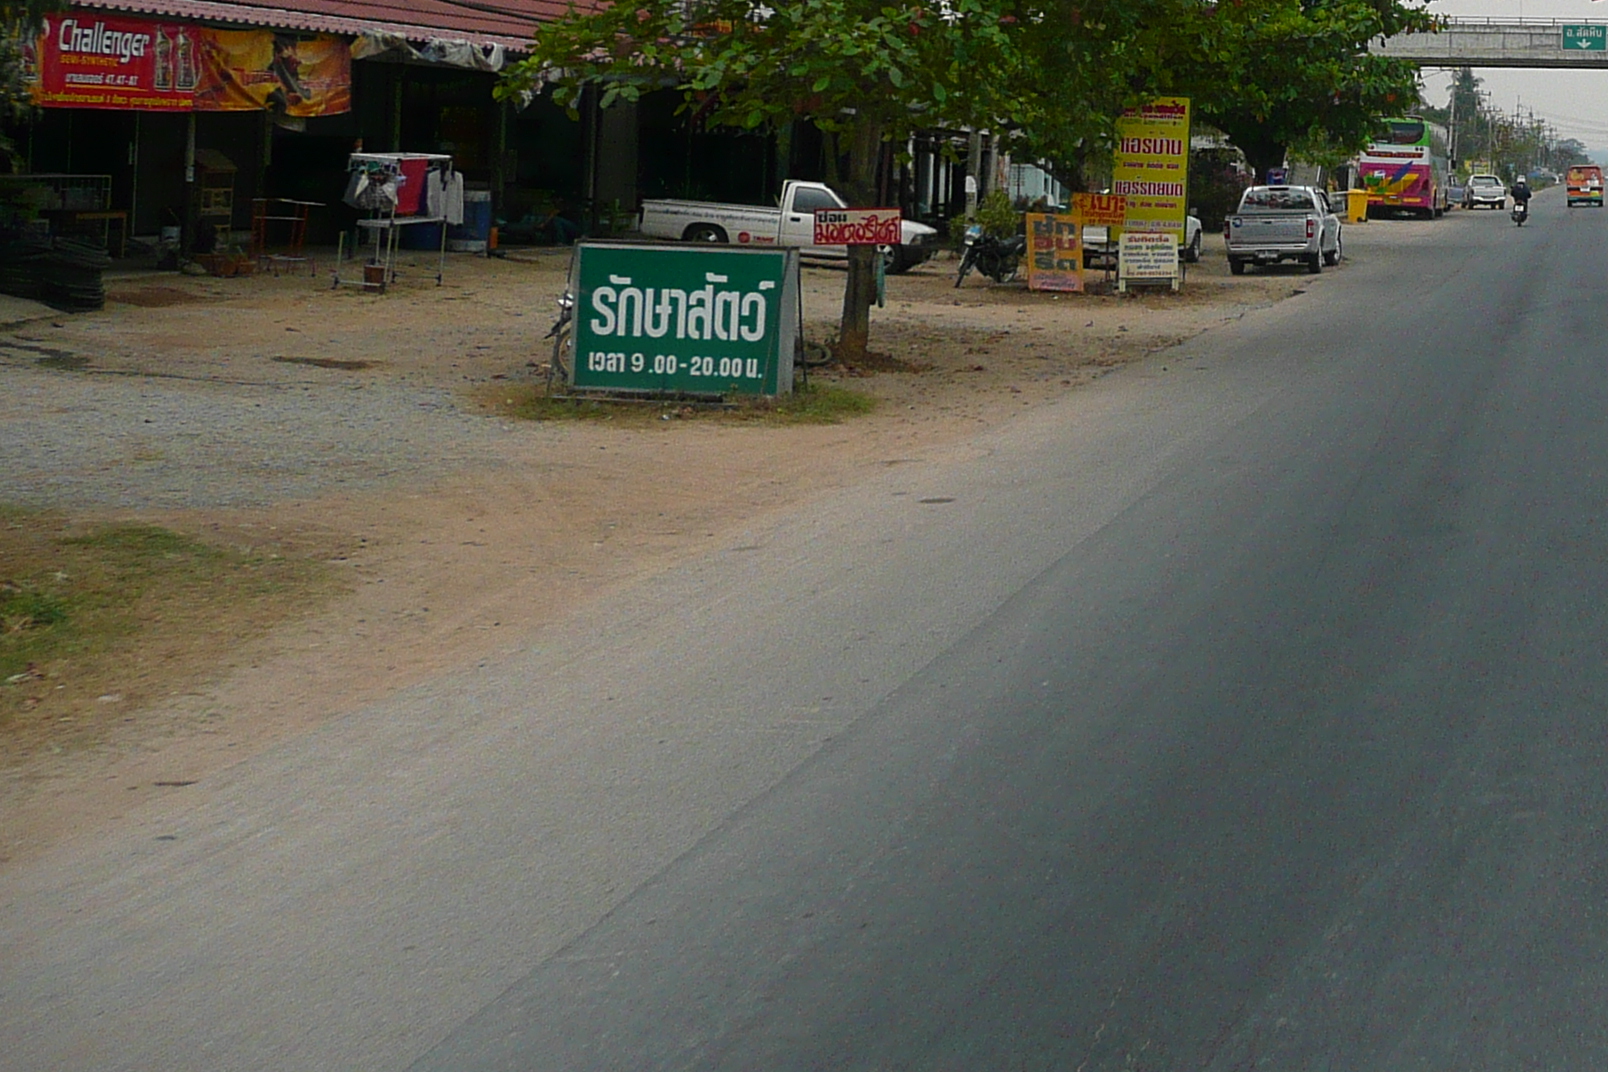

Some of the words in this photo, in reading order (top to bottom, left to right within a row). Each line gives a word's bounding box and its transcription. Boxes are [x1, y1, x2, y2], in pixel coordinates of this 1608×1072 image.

[58, 18, 150, 64] Challenger
[1120, 130, 1182, 156] แอร์บ้าน
[1115, 175, 1184, 197] แอร์รถยนต์
[1091, 194, 1126, 213] เบาะ
[817, 210, 848, 223] ซ่อม
[590, 272, 776, 342] รักษาสัตว์
[588, 352, 626, 373] เวลา
